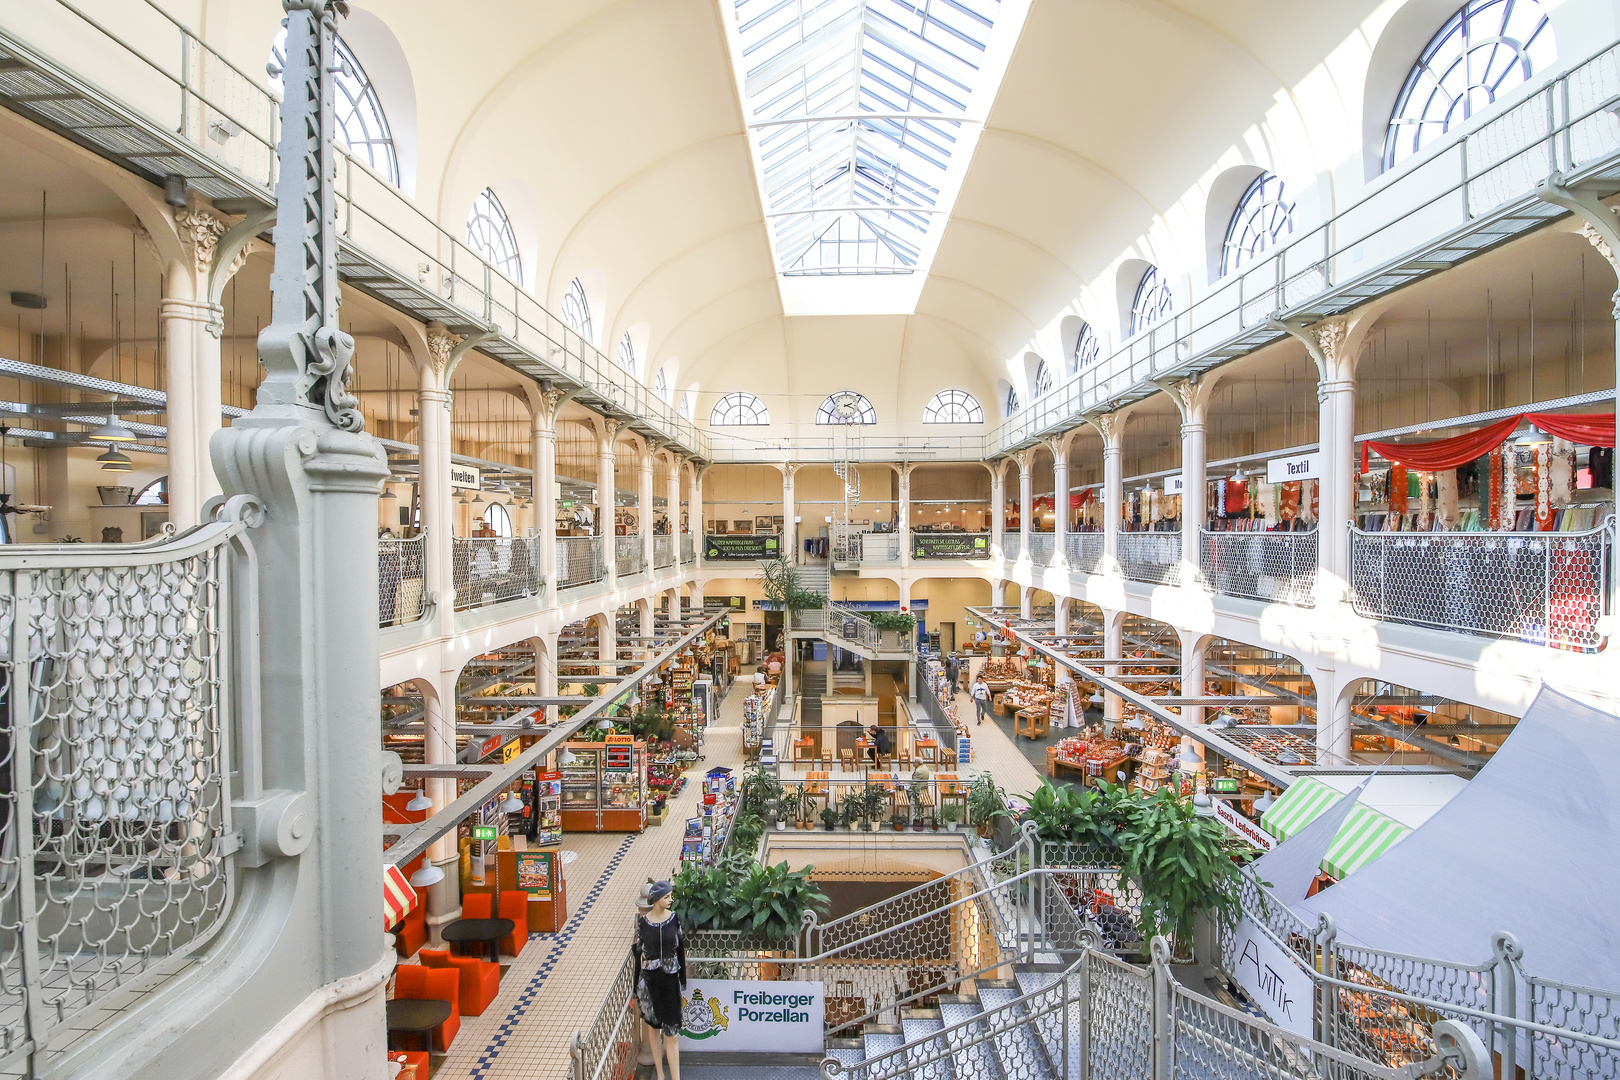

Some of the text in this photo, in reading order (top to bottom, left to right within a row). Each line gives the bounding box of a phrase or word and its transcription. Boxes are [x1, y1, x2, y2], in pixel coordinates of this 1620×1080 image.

[1286, 460, 1309, 475] Textil
[1216, 804, 1271, 851] Sasch Lederbörse
[733, 990, 814, 1008] Freiberger
[738, 1008, 809, 1022] Porzellan
